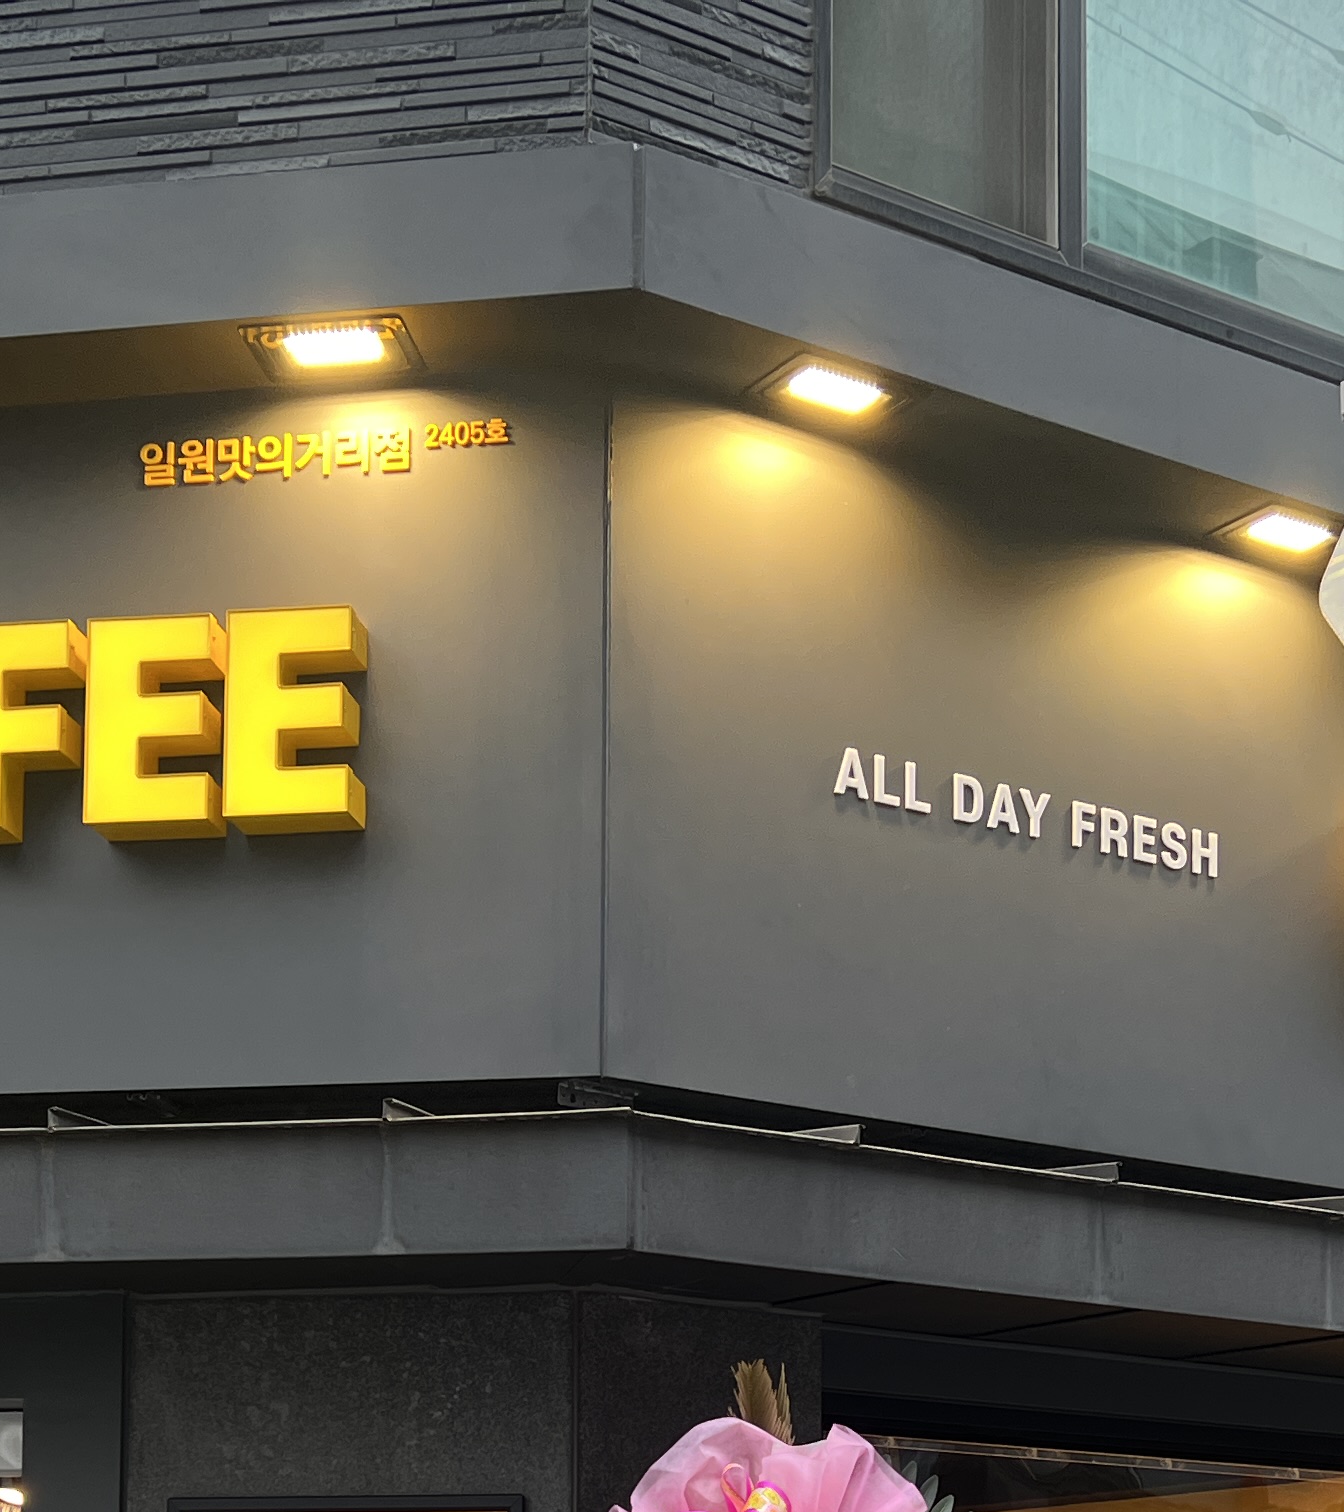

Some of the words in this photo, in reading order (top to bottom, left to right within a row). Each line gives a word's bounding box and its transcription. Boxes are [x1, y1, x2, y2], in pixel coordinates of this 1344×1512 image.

[139, 426, 413, 487] 일원맛의거리점
[423, 417, 510, 450] 2405호
[832, 746, 932, 815] ALL
[952, 770, 1054, 841] DAY
[1069, 798, 1221, 880] FRESH
